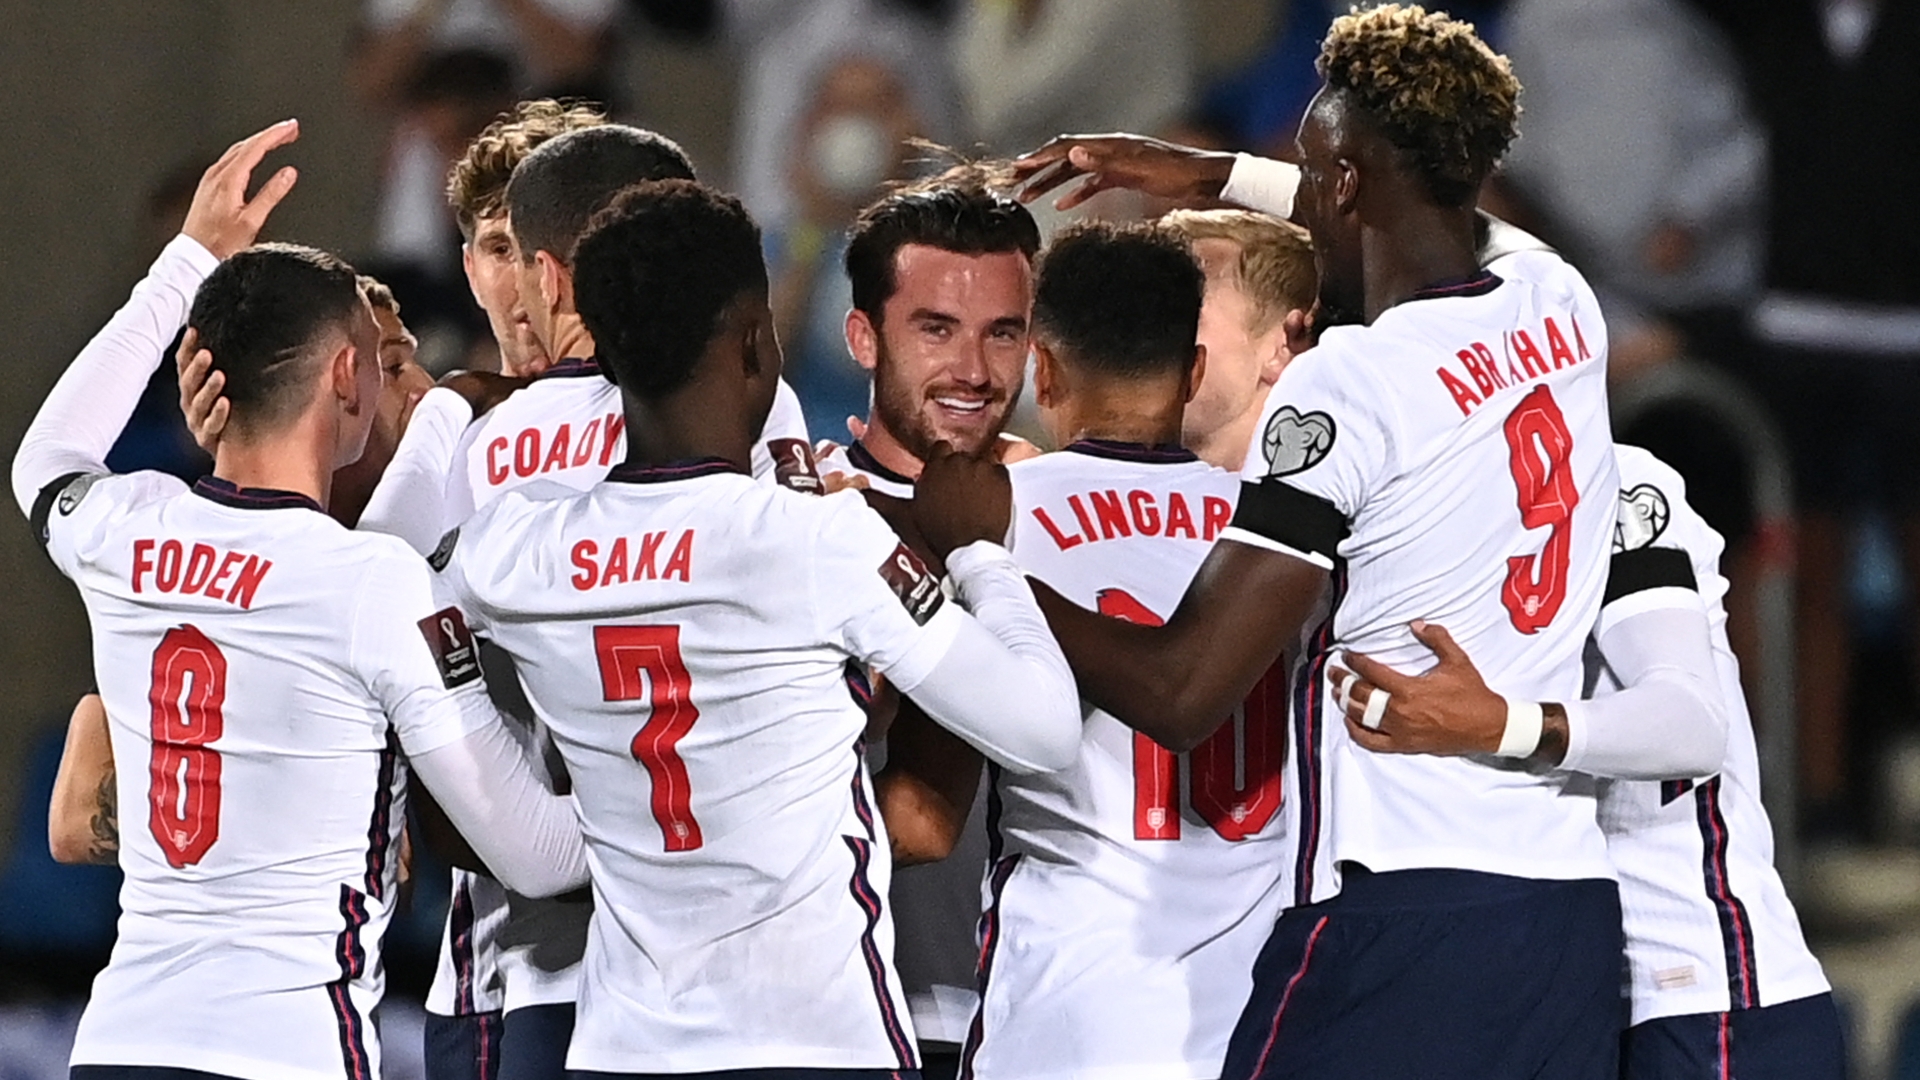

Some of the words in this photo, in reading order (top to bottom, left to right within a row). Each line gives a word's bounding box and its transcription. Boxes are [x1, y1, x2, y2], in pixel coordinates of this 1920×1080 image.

[487, 413, 626, 486] COADY
[1501, 383, 1581, 635] 9
[132, 538, 273, 610] FODEN
[571, 529, 695, 592] SAKA
[149, 624, 229, 869] 8
[594, 625, 704, 852] 7
